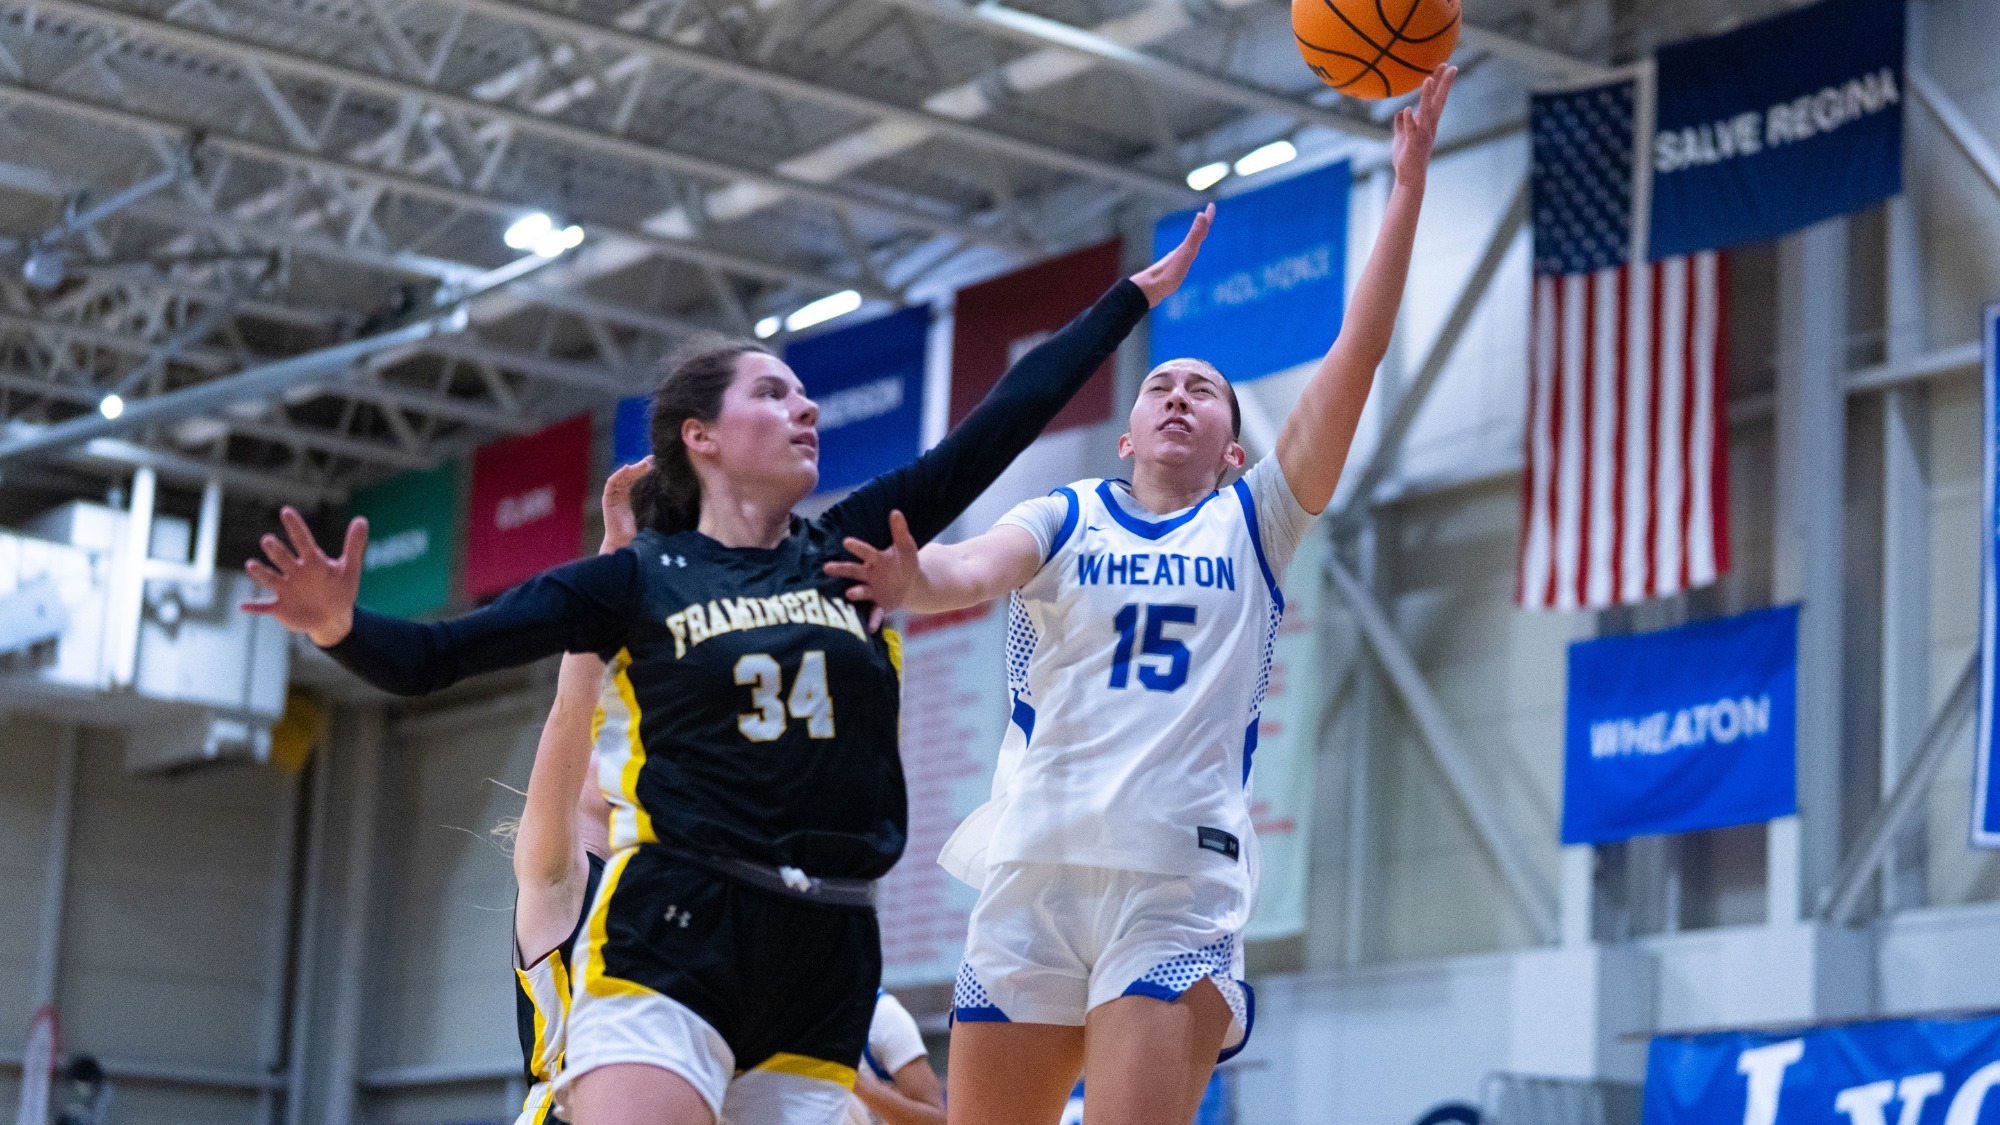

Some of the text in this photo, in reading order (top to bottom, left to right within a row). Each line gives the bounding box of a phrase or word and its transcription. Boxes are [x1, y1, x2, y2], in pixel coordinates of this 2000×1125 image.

[1655, 67, 1898, 173] SALVE REGINA
[1078, 553, 1235, 591] WHEATON
[1107, 602, 1198, 693] 15
[733, 650, 835, 742] 34
[1590, 694, 1771, 758] WHEATON
